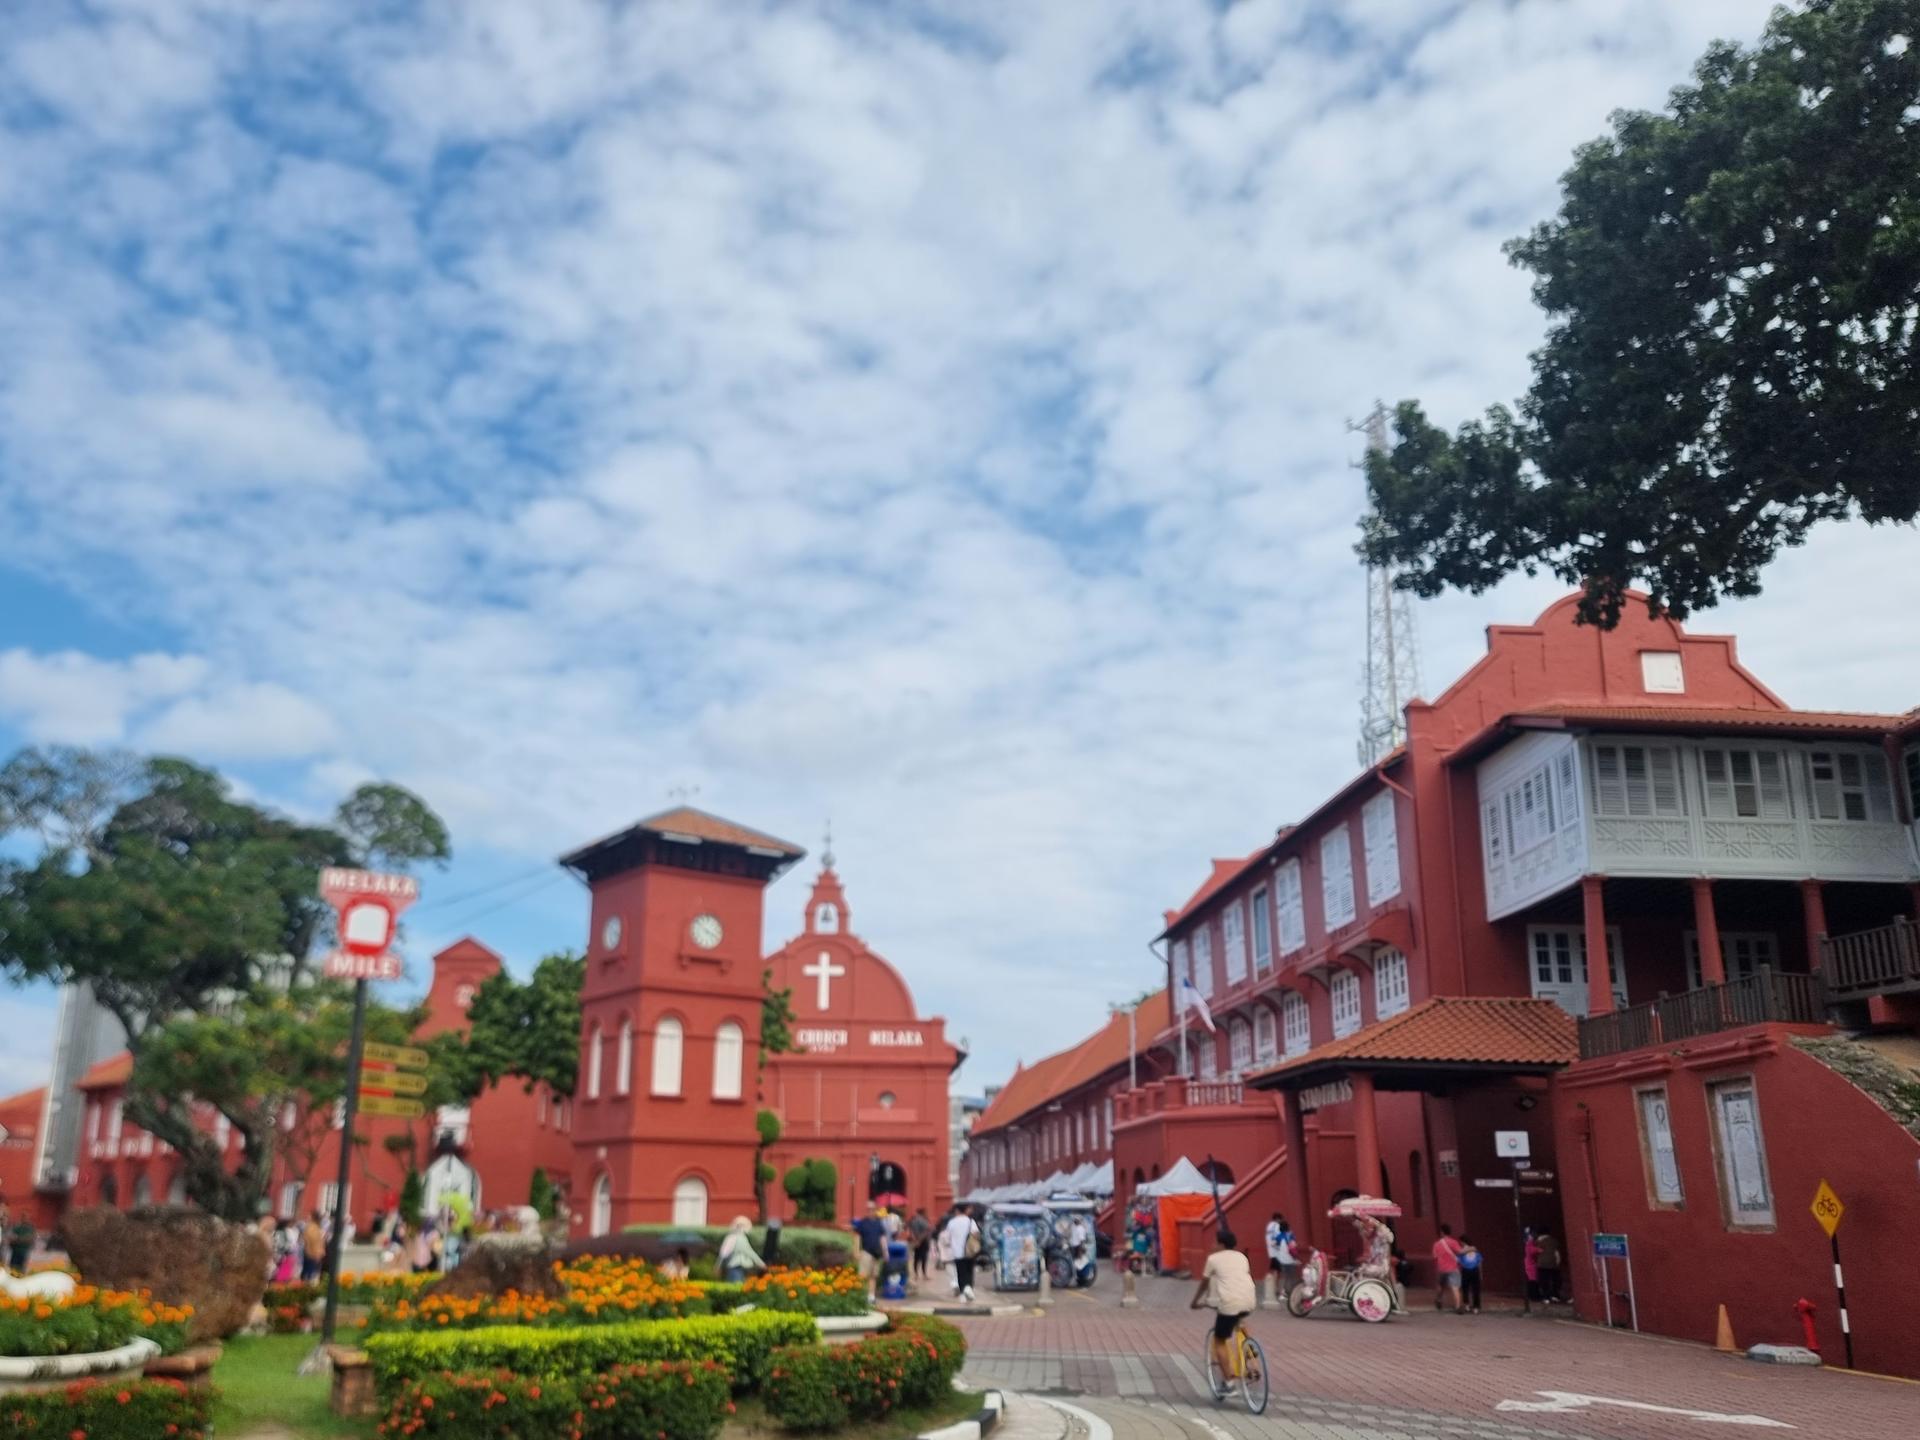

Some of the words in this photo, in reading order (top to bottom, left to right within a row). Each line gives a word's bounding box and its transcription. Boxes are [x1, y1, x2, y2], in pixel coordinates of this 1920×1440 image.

[327, 871, 416, 896] MELAKA
[333, 955, 394, 975] MILE
[796, 1029, 848, 1046] CHURCH
[869, 1030, 924, 1046] MELAKA
